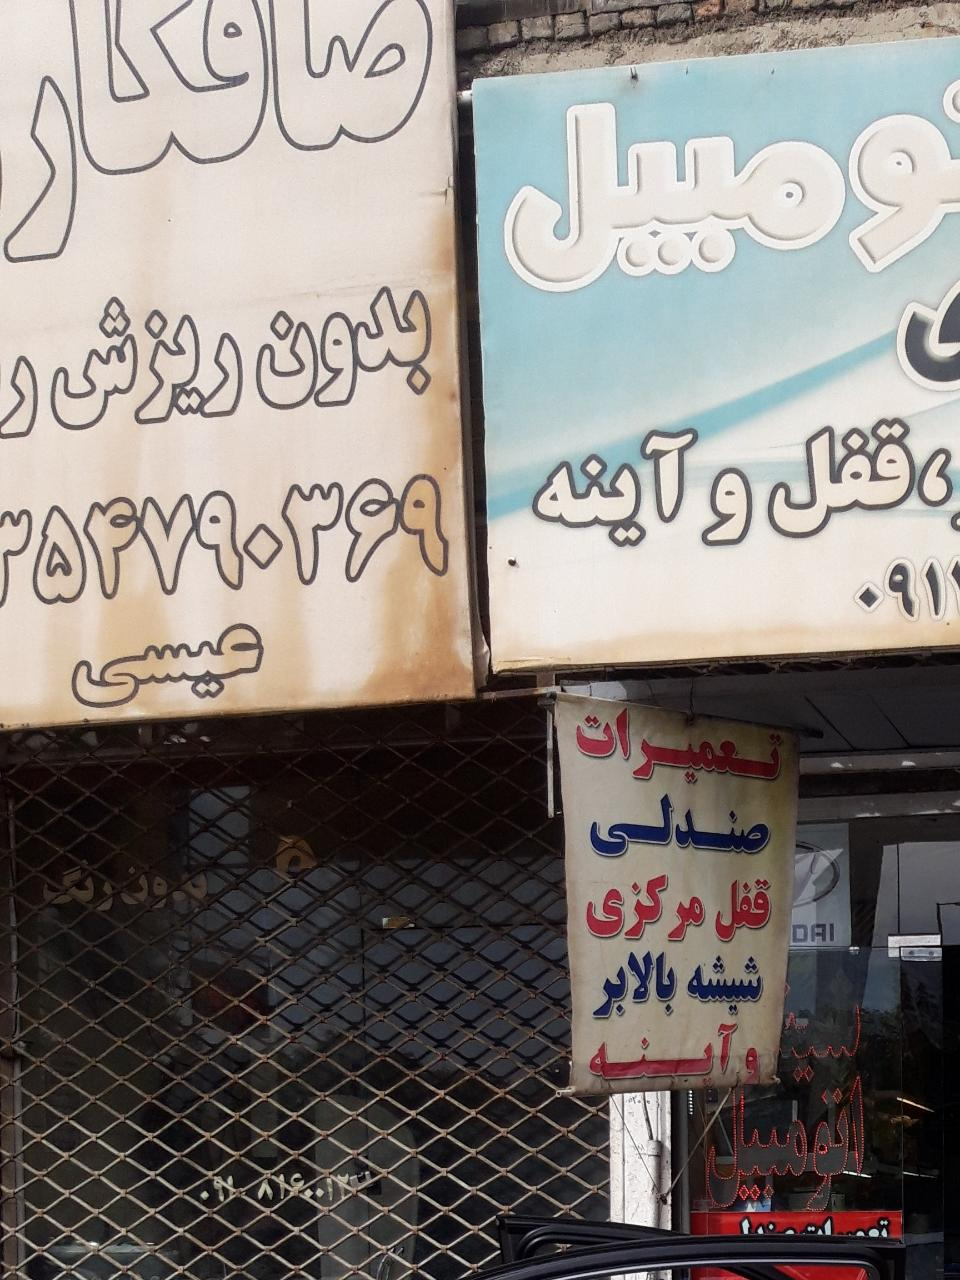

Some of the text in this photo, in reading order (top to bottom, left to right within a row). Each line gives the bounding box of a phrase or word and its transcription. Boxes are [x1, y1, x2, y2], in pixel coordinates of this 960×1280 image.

[0, 0, 433, 262] صافکار
[51, 297, 242, 429] ریزش
[257, 287, 431, 408] بدون
[532, 428, 698, 547] آینه
[702, 468, 753, 546] و
[769, 418, 917, 537] قفل
[72, 623, 263, 707] عیسی
[576, 707, 782, 783] تعمیرات
[589, 793, 771, 857] صندلی
[585, 873, 772, 942] قفل مرکزی
[592, 950, 765, 1019] شیشه بالابر
